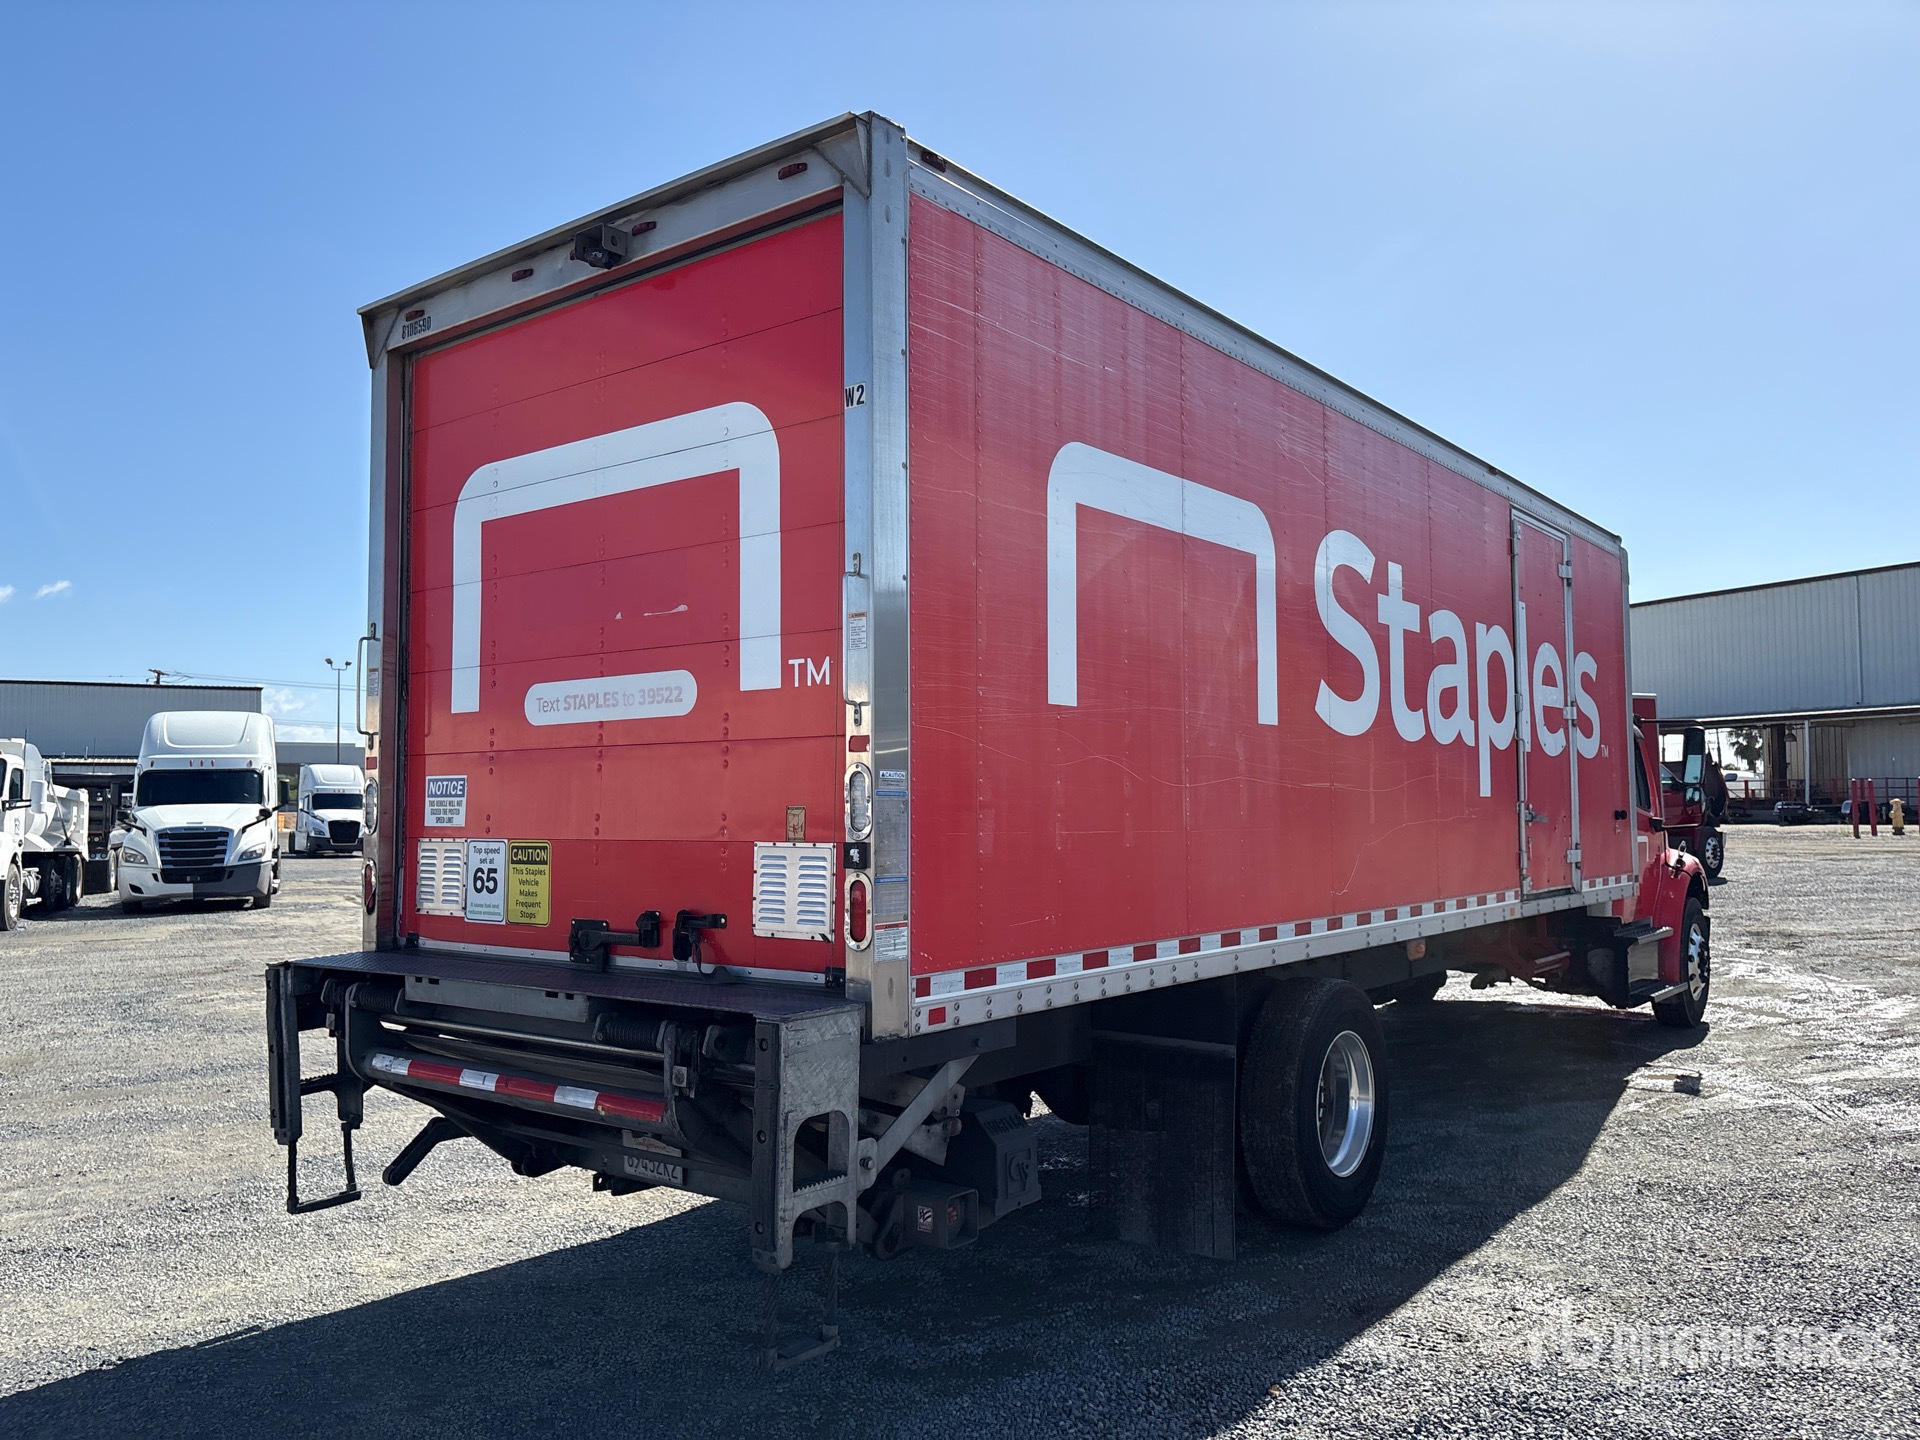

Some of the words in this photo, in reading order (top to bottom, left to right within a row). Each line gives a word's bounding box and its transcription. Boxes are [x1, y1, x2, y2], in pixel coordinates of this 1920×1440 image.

[401, 315, 432, 340] 8106590
[845, 384, 865, 407] W2
[1314, 528, 1601, 798] Staples
[787, 655, 830, 688] TM
[535, 696, 561, 714] Text
[563, 691, 619, 712] STAPLES
[622, 690, 635, 707] to
[638, 685, 683, 706] 39522
[1601, 744, 1609, 758] TM
[429, 780, 464, 795] NOTICE
[428, 800, 436, 808] THIS
[436, 800, 448, 808] VEHICLE
[448, 800, 456, 808] WILL
[430, 808, 441, 816] EXCEED
[435, 816, 445, 824] SPEED
[473, 846, 483, 855] Top
[484, 846, 501, 855] speed
[512, 848, 547, 862] CAUTION
[479, 857, 488, 865] set
[489, 857, 495, 865] at
[512, 867, 524, 875] This
[525, 867, 546, 877] Staples
[472, 867, 498, 895] 65
[518, 878, 539, 887] Vehicle
[519, 888, 538, 897] Makes
[515, 899, 542, 909] Frequent
[519, 911, 537, 920] Stops
